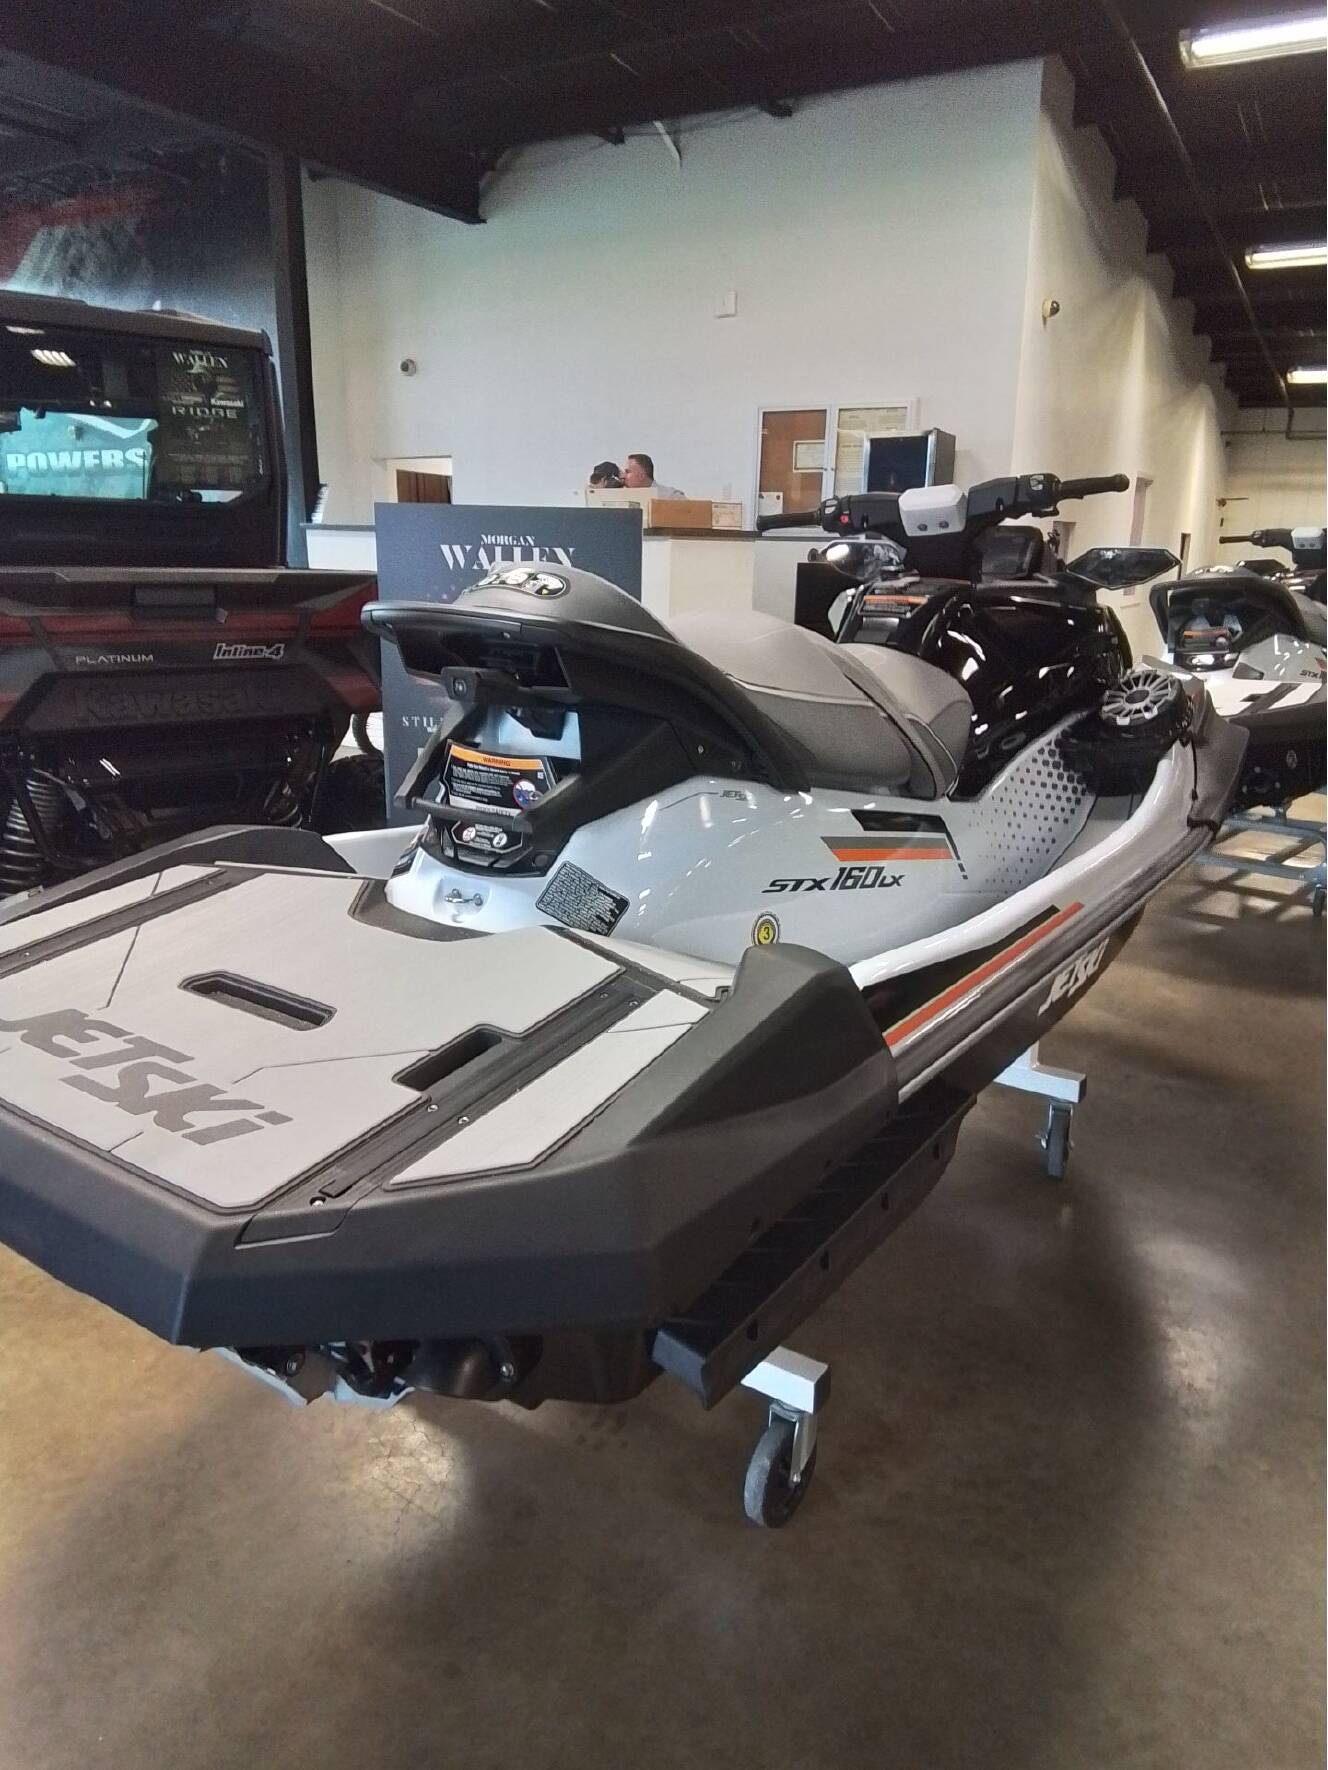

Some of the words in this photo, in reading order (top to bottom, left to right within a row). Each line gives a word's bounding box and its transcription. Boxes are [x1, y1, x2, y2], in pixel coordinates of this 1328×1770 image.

[6, 447, 147, 473] POWERS
[480, 533, 536, 547] MORGAN
[75, 653, 155, 665] PLATINUM
[482, 756, 511, 767] WARNING
